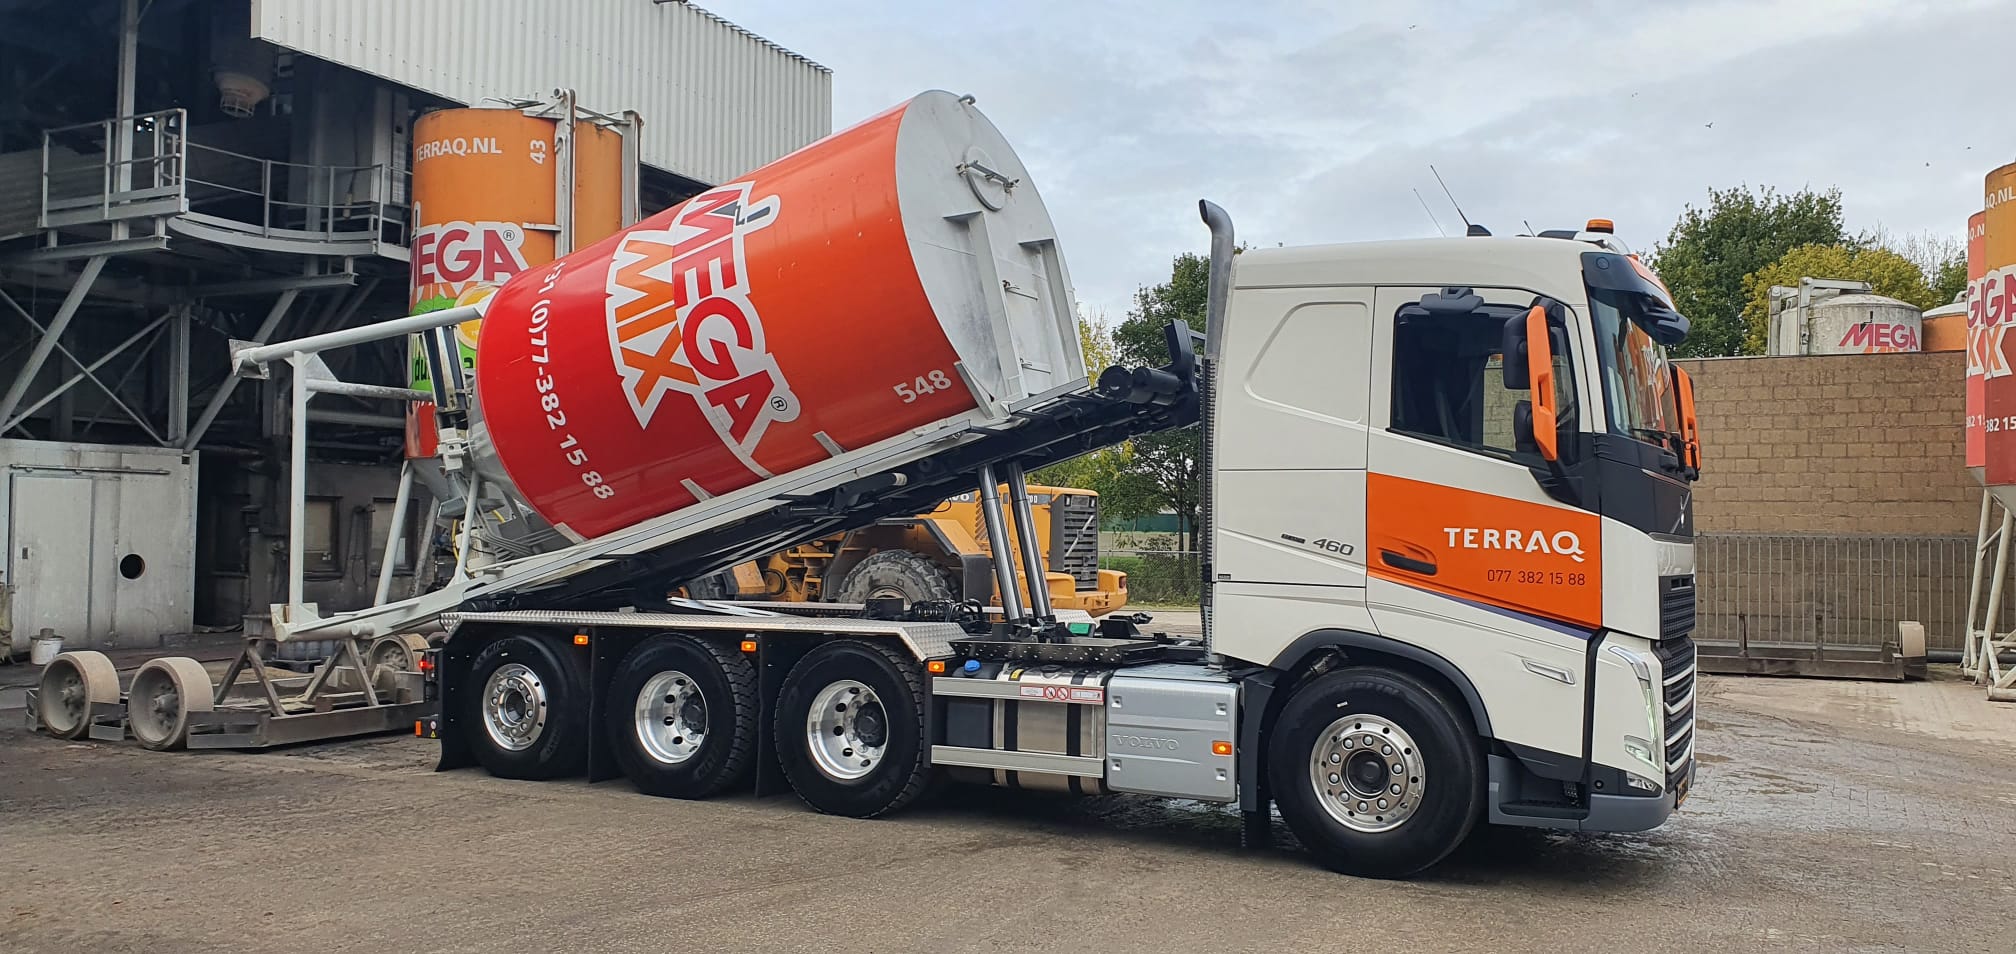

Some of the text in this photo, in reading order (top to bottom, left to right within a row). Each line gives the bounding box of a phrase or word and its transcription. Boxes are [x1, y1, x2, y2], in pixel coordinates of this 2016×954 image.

[416, 137, 503, 162] TERRAQ.NL
[530, 139, 546, 165] 43
[614, 239, 701, 408] MIX
[673, 189, 775, 446] MEGA
[1838, 323, 1918, 351] MEGA
[528, 299, 567, 430] (0)77-382
[560, 433, 588, 466] 15
[581, 470, 615, 499] 88
[893, 369, 952, 403] 548
[1313, 538, 1355, 556] 460
[1443, 527, 1585, 563] TERRAQ
[1487, 569, 1586, 586] 077 382 15 88
[1111, 734, 1180, 751] VOLVO
